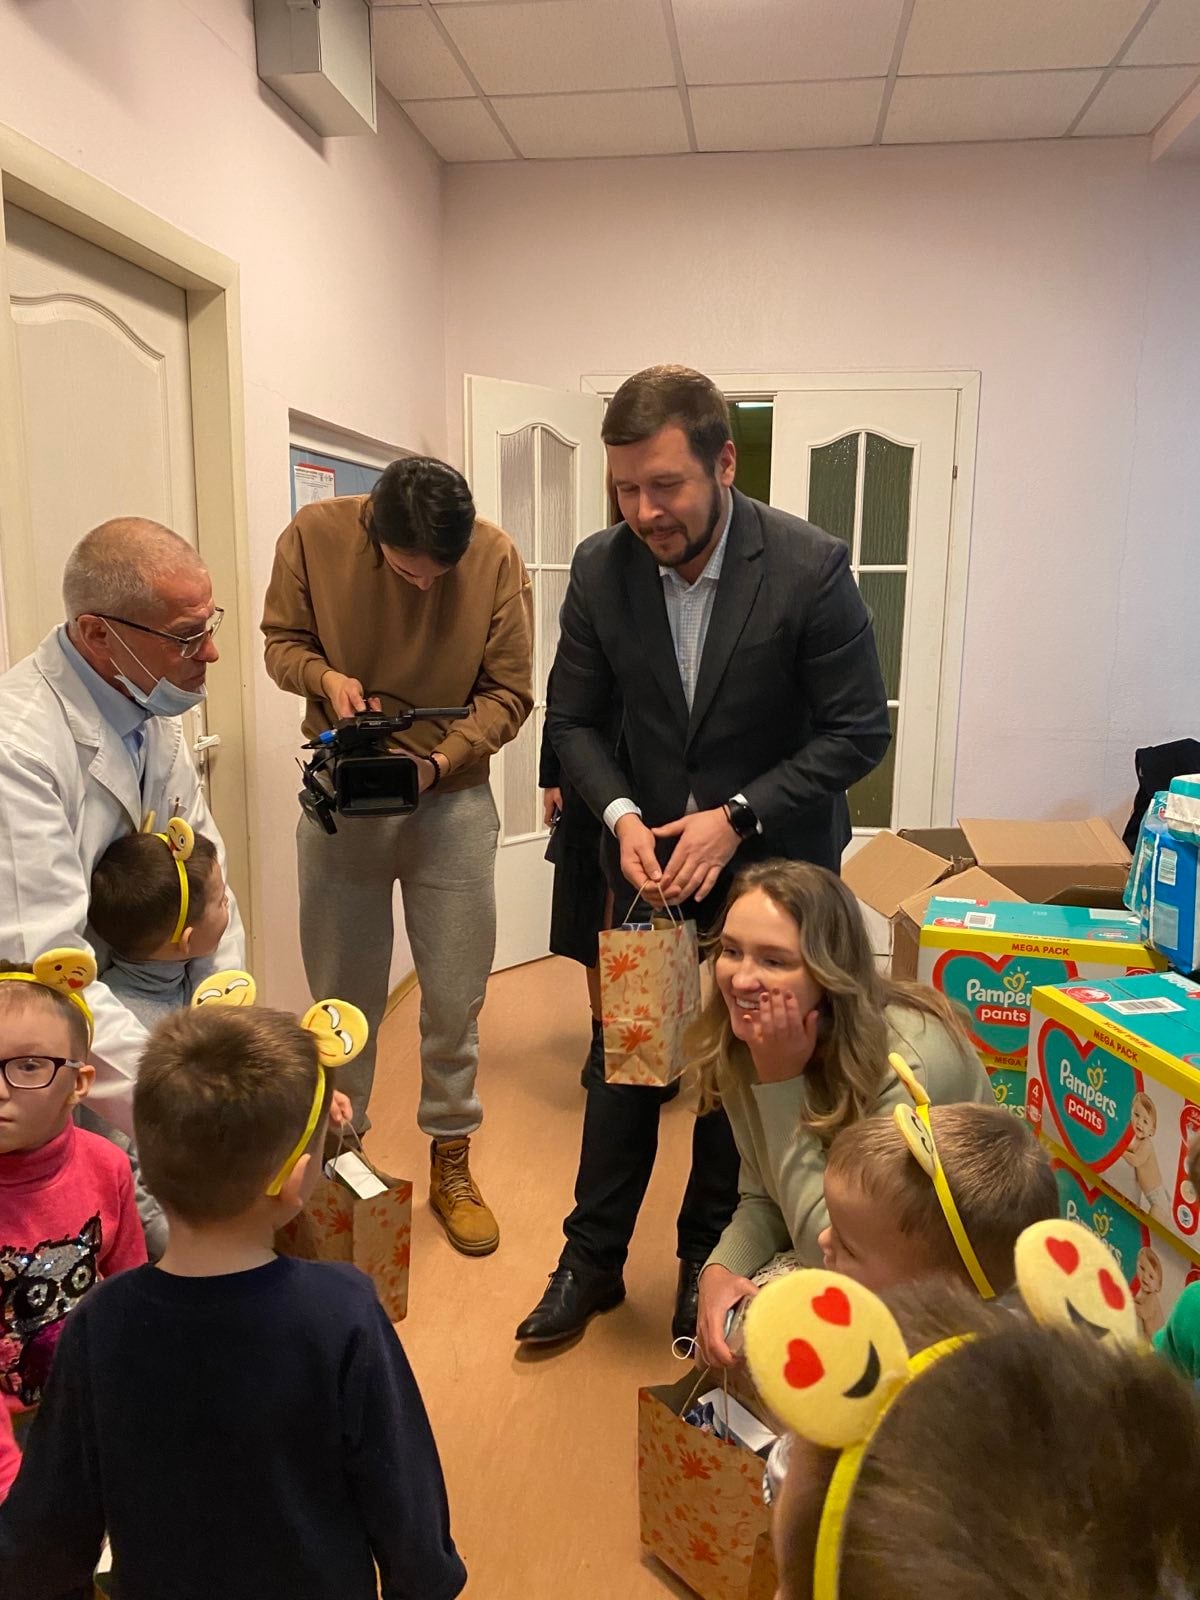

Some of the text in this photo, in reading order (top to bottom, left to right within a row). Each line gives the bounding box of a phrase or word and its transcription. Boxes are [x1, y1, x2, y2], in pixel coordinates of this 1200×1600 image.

[1011, 943, 1070, 956] MEGA PACK
[966, 978, 1032, 1008] Pamper
[981, 1008, 1027, 1022] pants
[994, 1056, 1022, 1066] MEGA
[1093, 1029, 1115, 1049] MEGA
[1116, 1043, 1138, 1063] PACK
[1060, 1058, 1117, 1119] Pampers
[1068, 1098, 1102, 1130] pants
